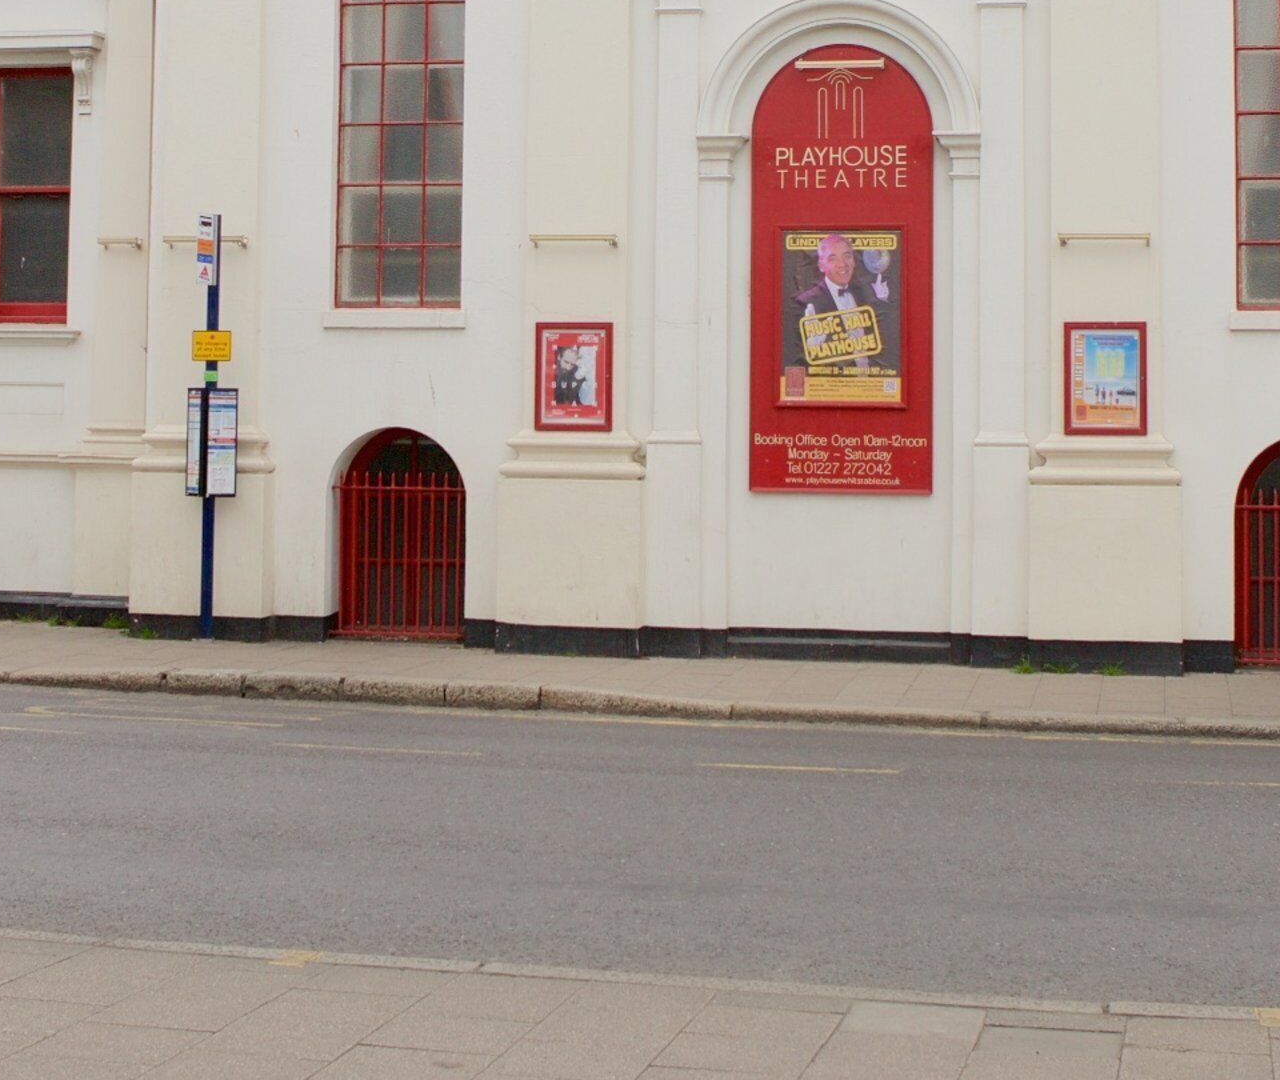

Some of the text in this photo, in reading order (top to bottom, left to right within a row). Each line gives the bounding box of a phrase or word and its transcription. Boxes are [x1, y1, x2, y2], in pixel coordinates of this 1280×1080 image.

[775, 145, 908, 166] PLAYHOUSE
[776, 167, 908, 189] THEATRE
[804, 317, 842, 336] MUSIC
[810, 334, 877, 359] PLAYHOUSE
[754, 432, 793, 448] Booking
[795, 433, 828, 446] Office
[831, 433, 861, 448] Open
[787, 447, 829, 462] Monday
[844, 447, 893, 462] Saturday
[843, 462, 892, 476] 272042
